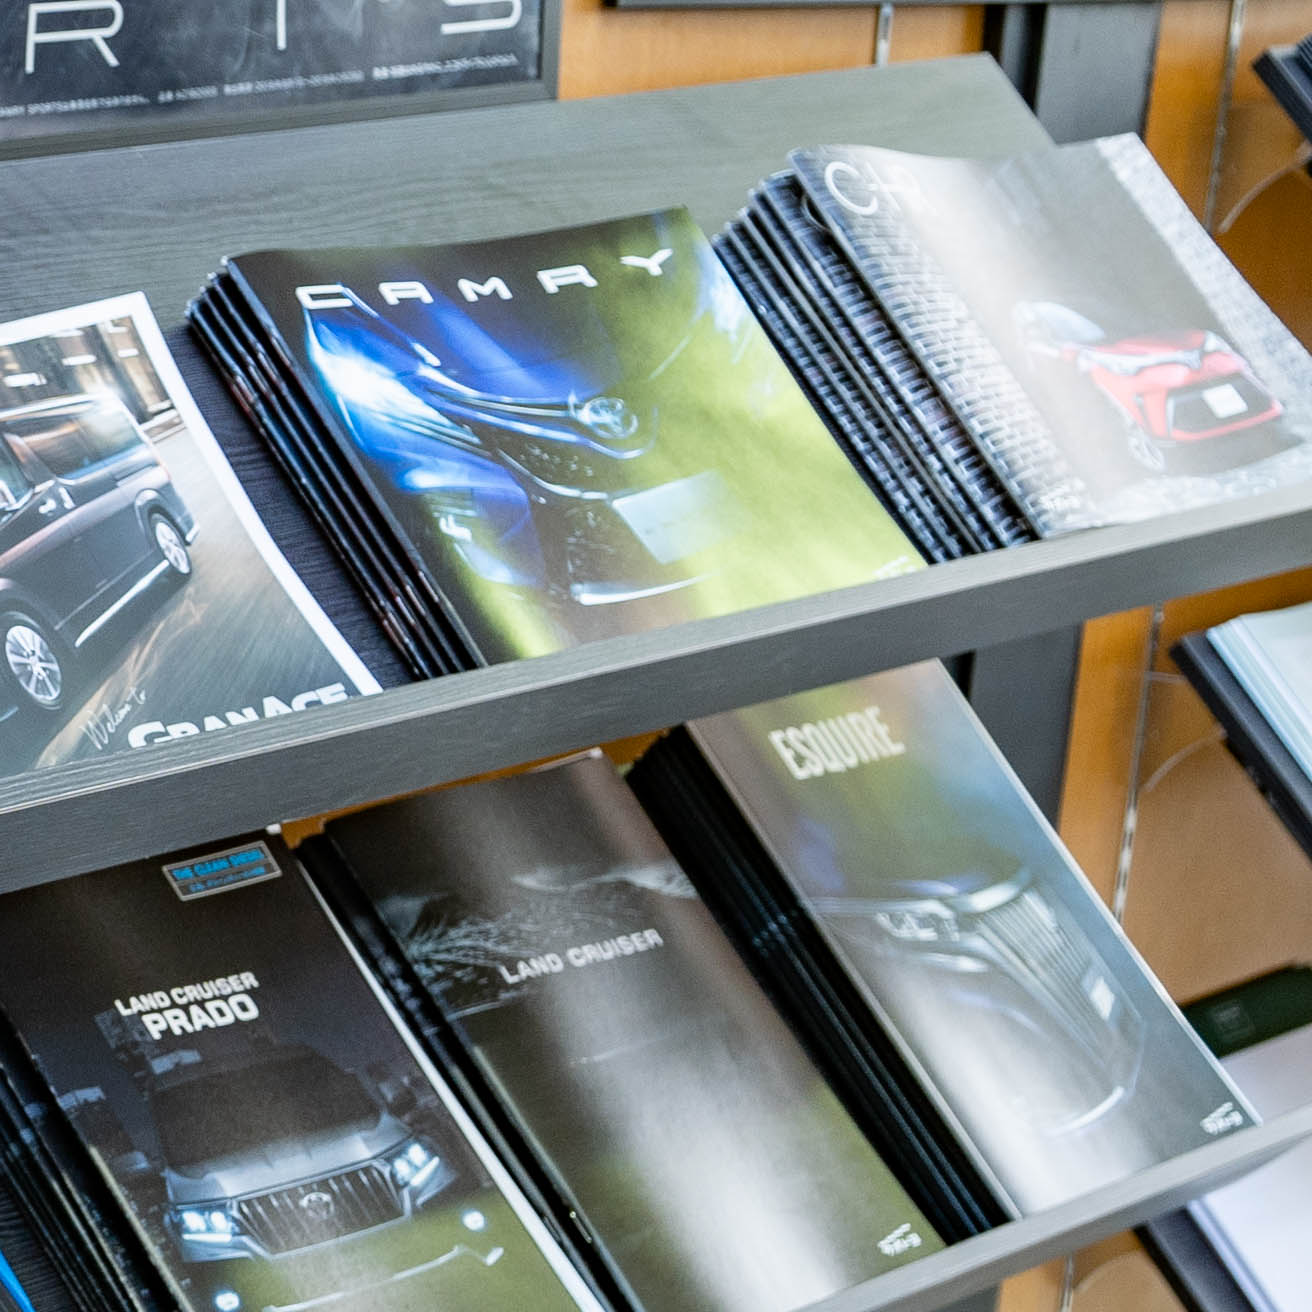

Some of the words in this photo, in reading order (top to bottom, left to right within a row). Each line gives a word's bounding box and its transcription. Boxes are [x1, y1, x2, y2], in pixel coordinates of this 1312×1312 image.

[769, 706, 906, 781] ESQUIRE
[499, 953, 564, 985] LAND
[566, 928, 664, 968] CRUISER
[114, 990, 171, 1016] LAND
[170, 971, 260, 1005] CRUISER
[141, 993, 260, 1040] PRADO
